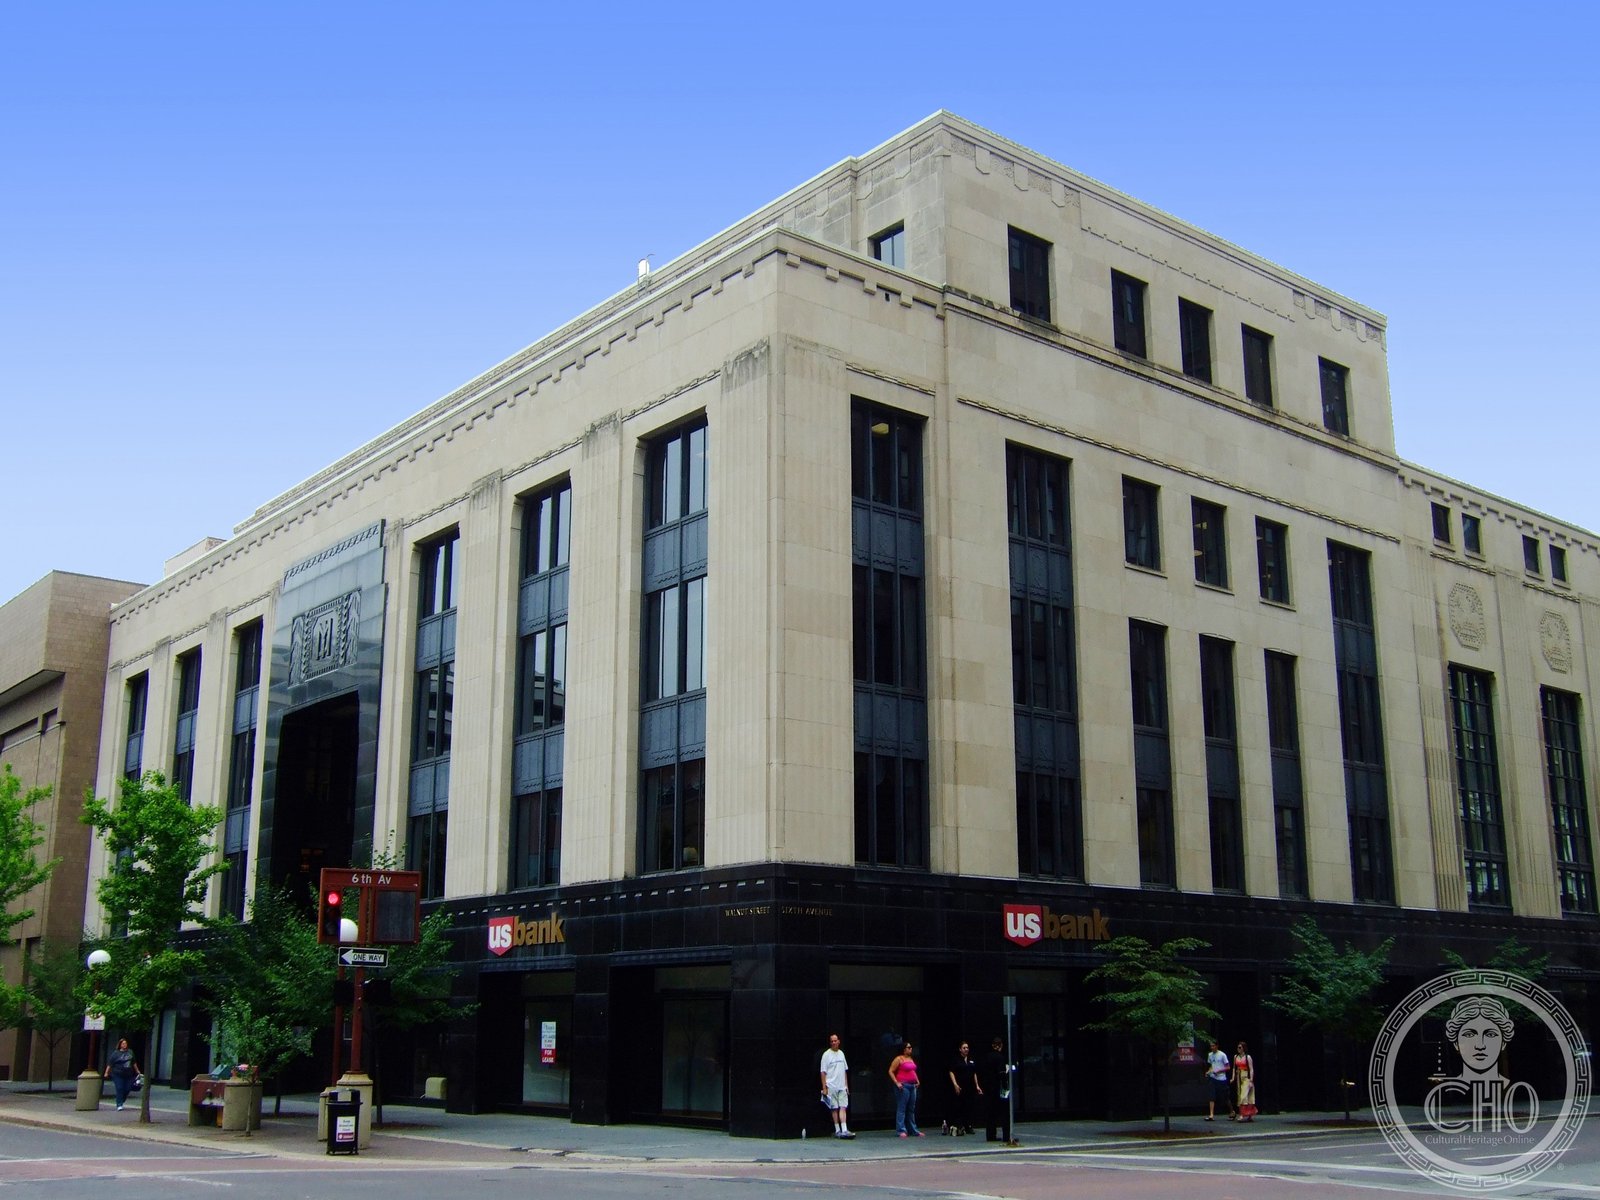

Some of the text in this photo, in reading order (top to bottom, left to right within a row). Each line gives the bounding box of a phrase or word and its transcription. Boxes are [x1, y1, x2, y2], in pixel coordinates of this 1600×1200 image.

[378, 874, 391, 885] Av
[749, 906, 771, 915] STREET
[781, 906, 833, 916] SIXTH AVENUE
[353, 953, 367, 961] ONE
